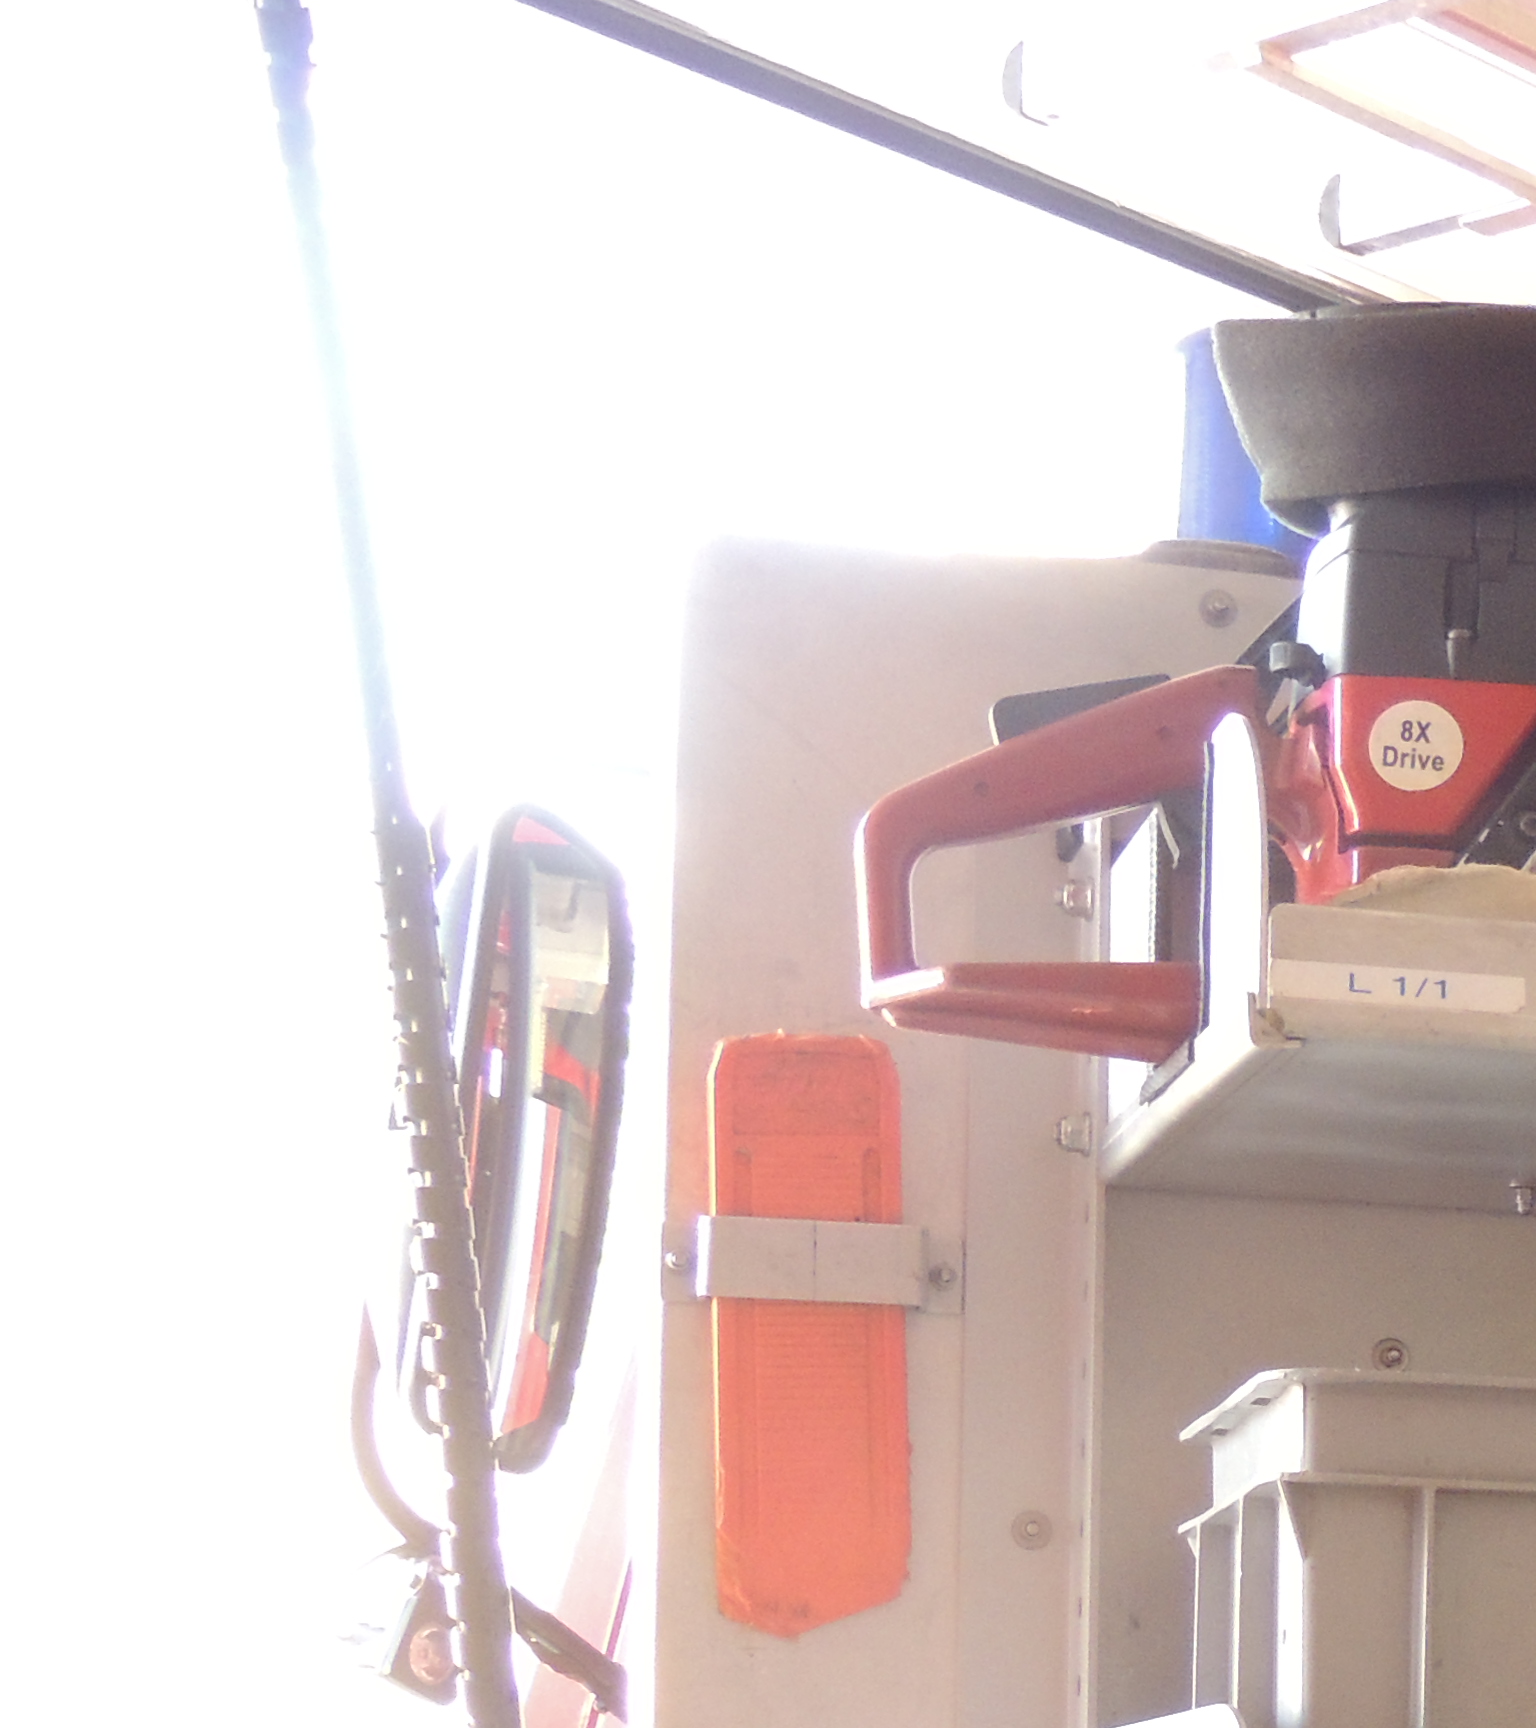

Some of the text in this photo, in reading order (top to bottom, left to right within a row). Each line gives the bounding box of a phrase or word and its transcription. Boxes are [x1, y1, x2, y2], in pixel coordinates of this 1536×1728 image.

[1400, 720, 1431, 744] 8X
[1383, 745, 1445, 771] Drive
[1349, 972, 1448, 999] L 1/1
